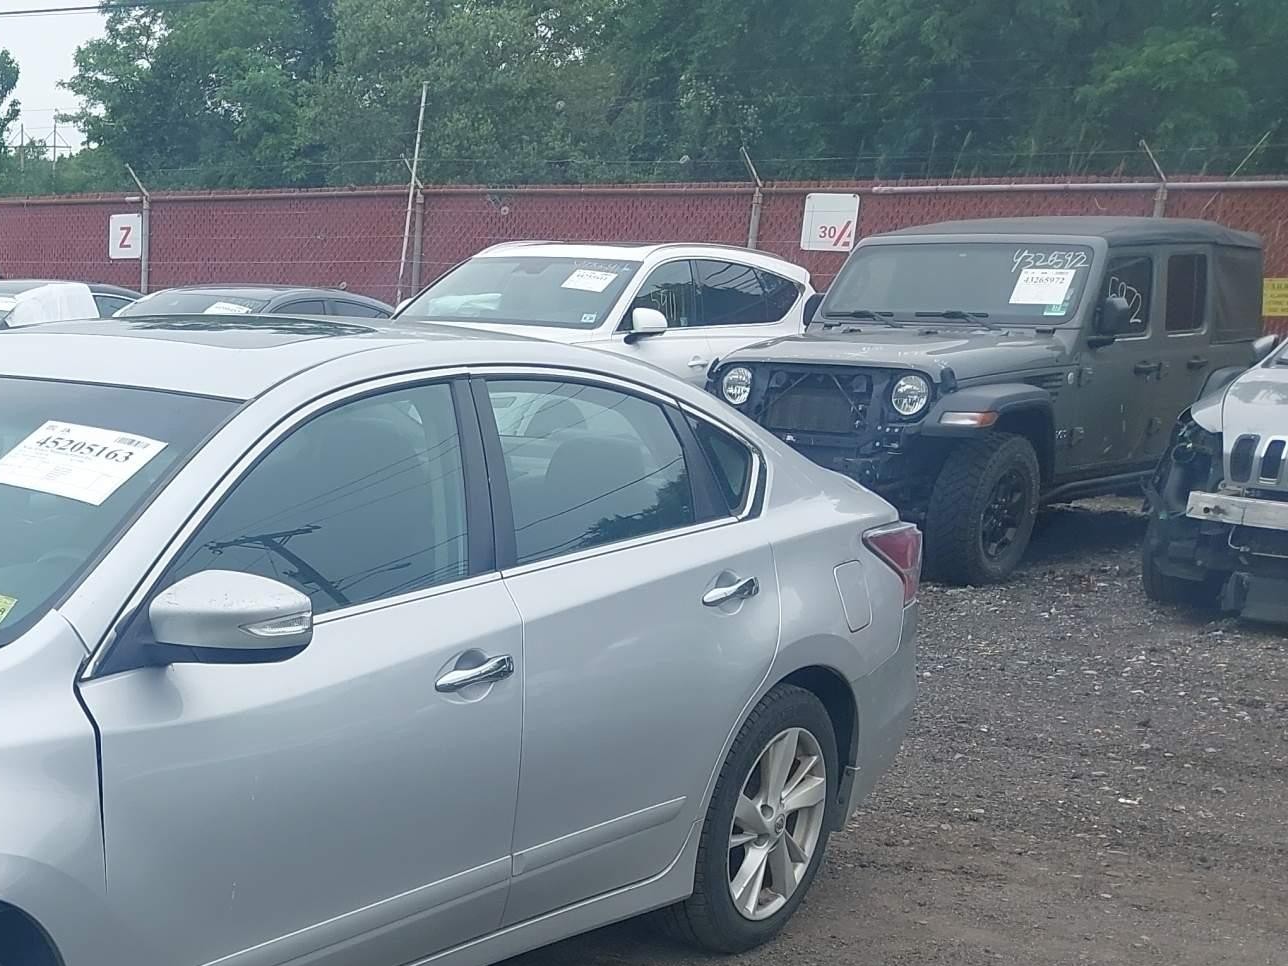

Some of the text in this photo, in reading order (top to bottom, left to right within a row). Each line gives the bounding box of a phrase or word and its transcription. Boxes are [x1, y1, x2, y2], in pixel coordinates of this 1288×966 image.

[119, 226, 132, 249] Z
[818, 225, 837, 239] 30
[36, 435, 134, 464] 45205163
